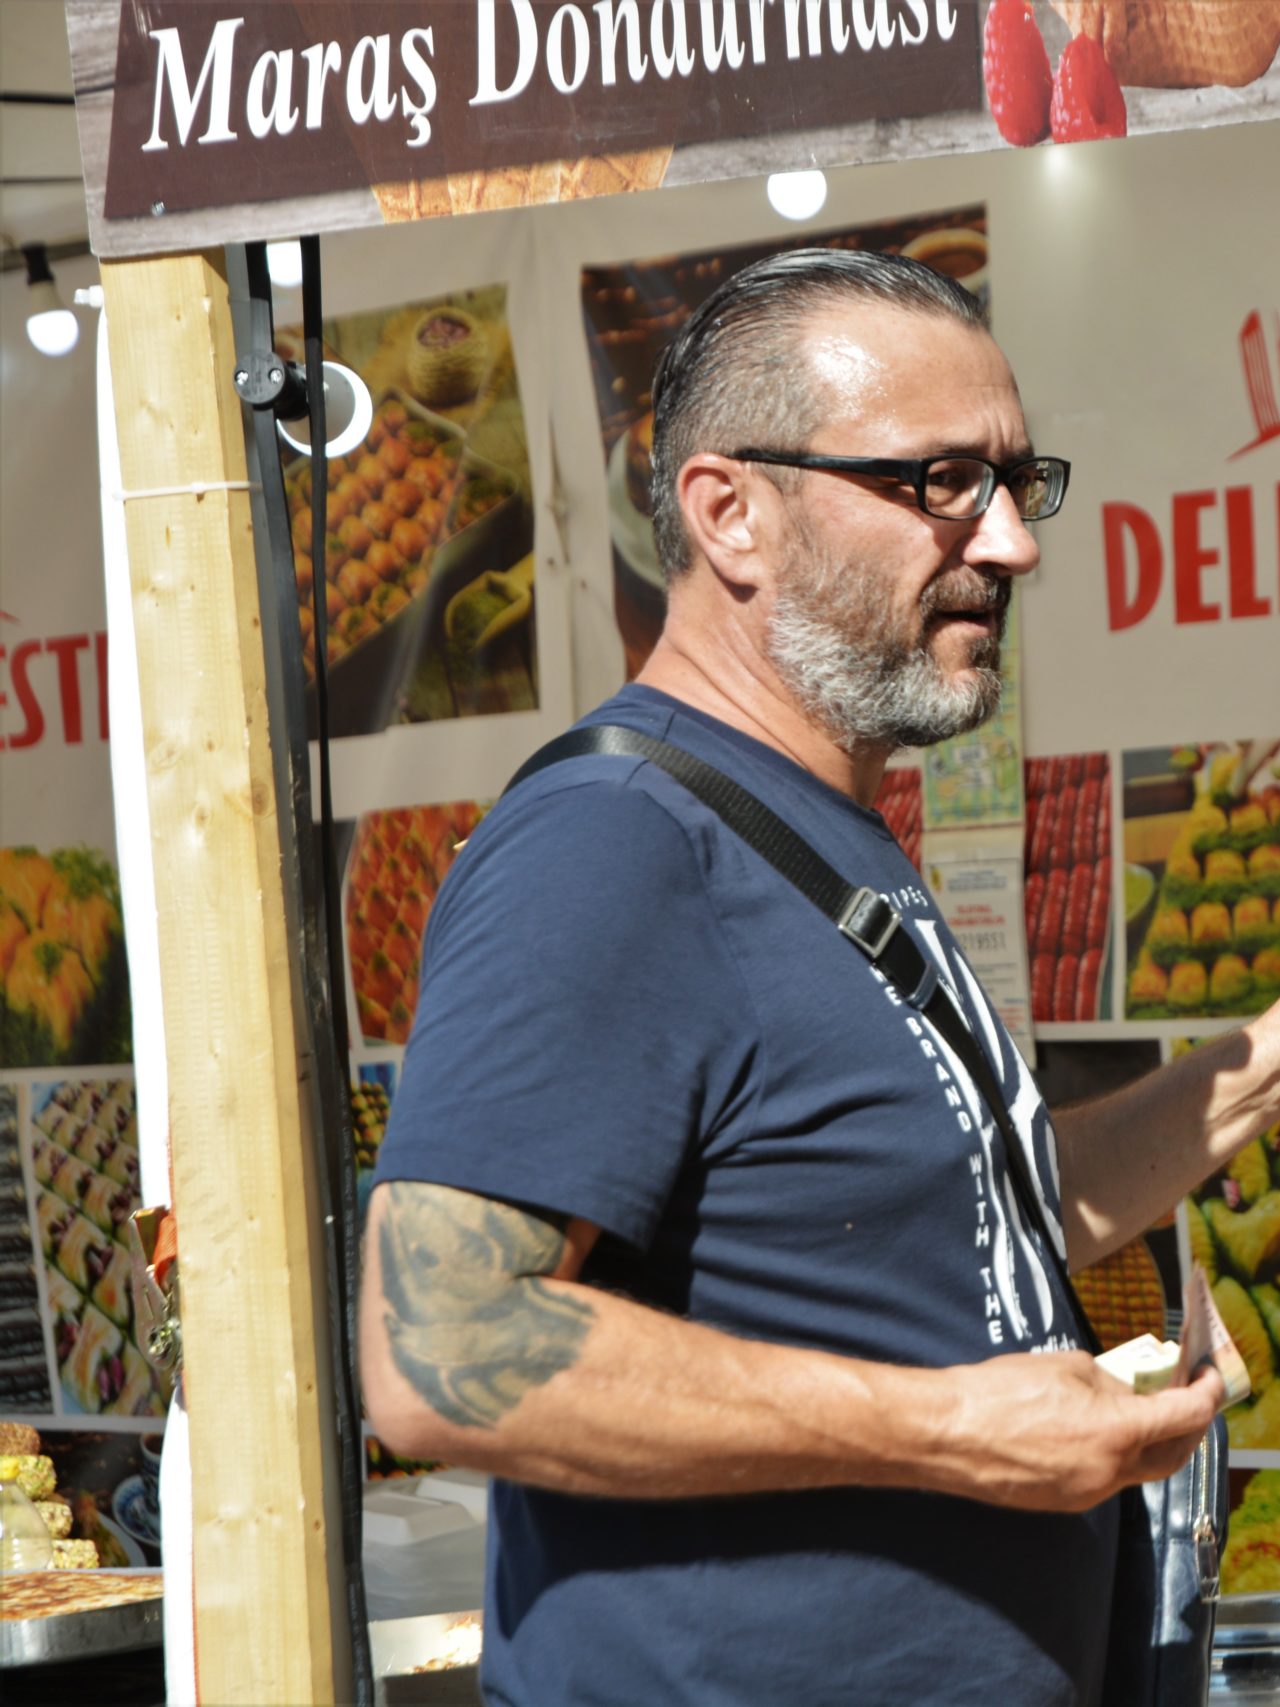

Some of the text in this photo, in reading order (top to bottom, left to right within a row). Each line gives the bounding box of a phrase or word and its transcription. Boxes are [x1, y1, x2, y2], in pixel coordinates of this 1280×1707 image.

[141, 17, 437, 152] Maraş
[0, 629, 109, 750] STI
[905, 1016, 972, 1133] BRAND
[968, 1151, 989, 1249] WITH
[979, 1266, 1004, 1345] THE
